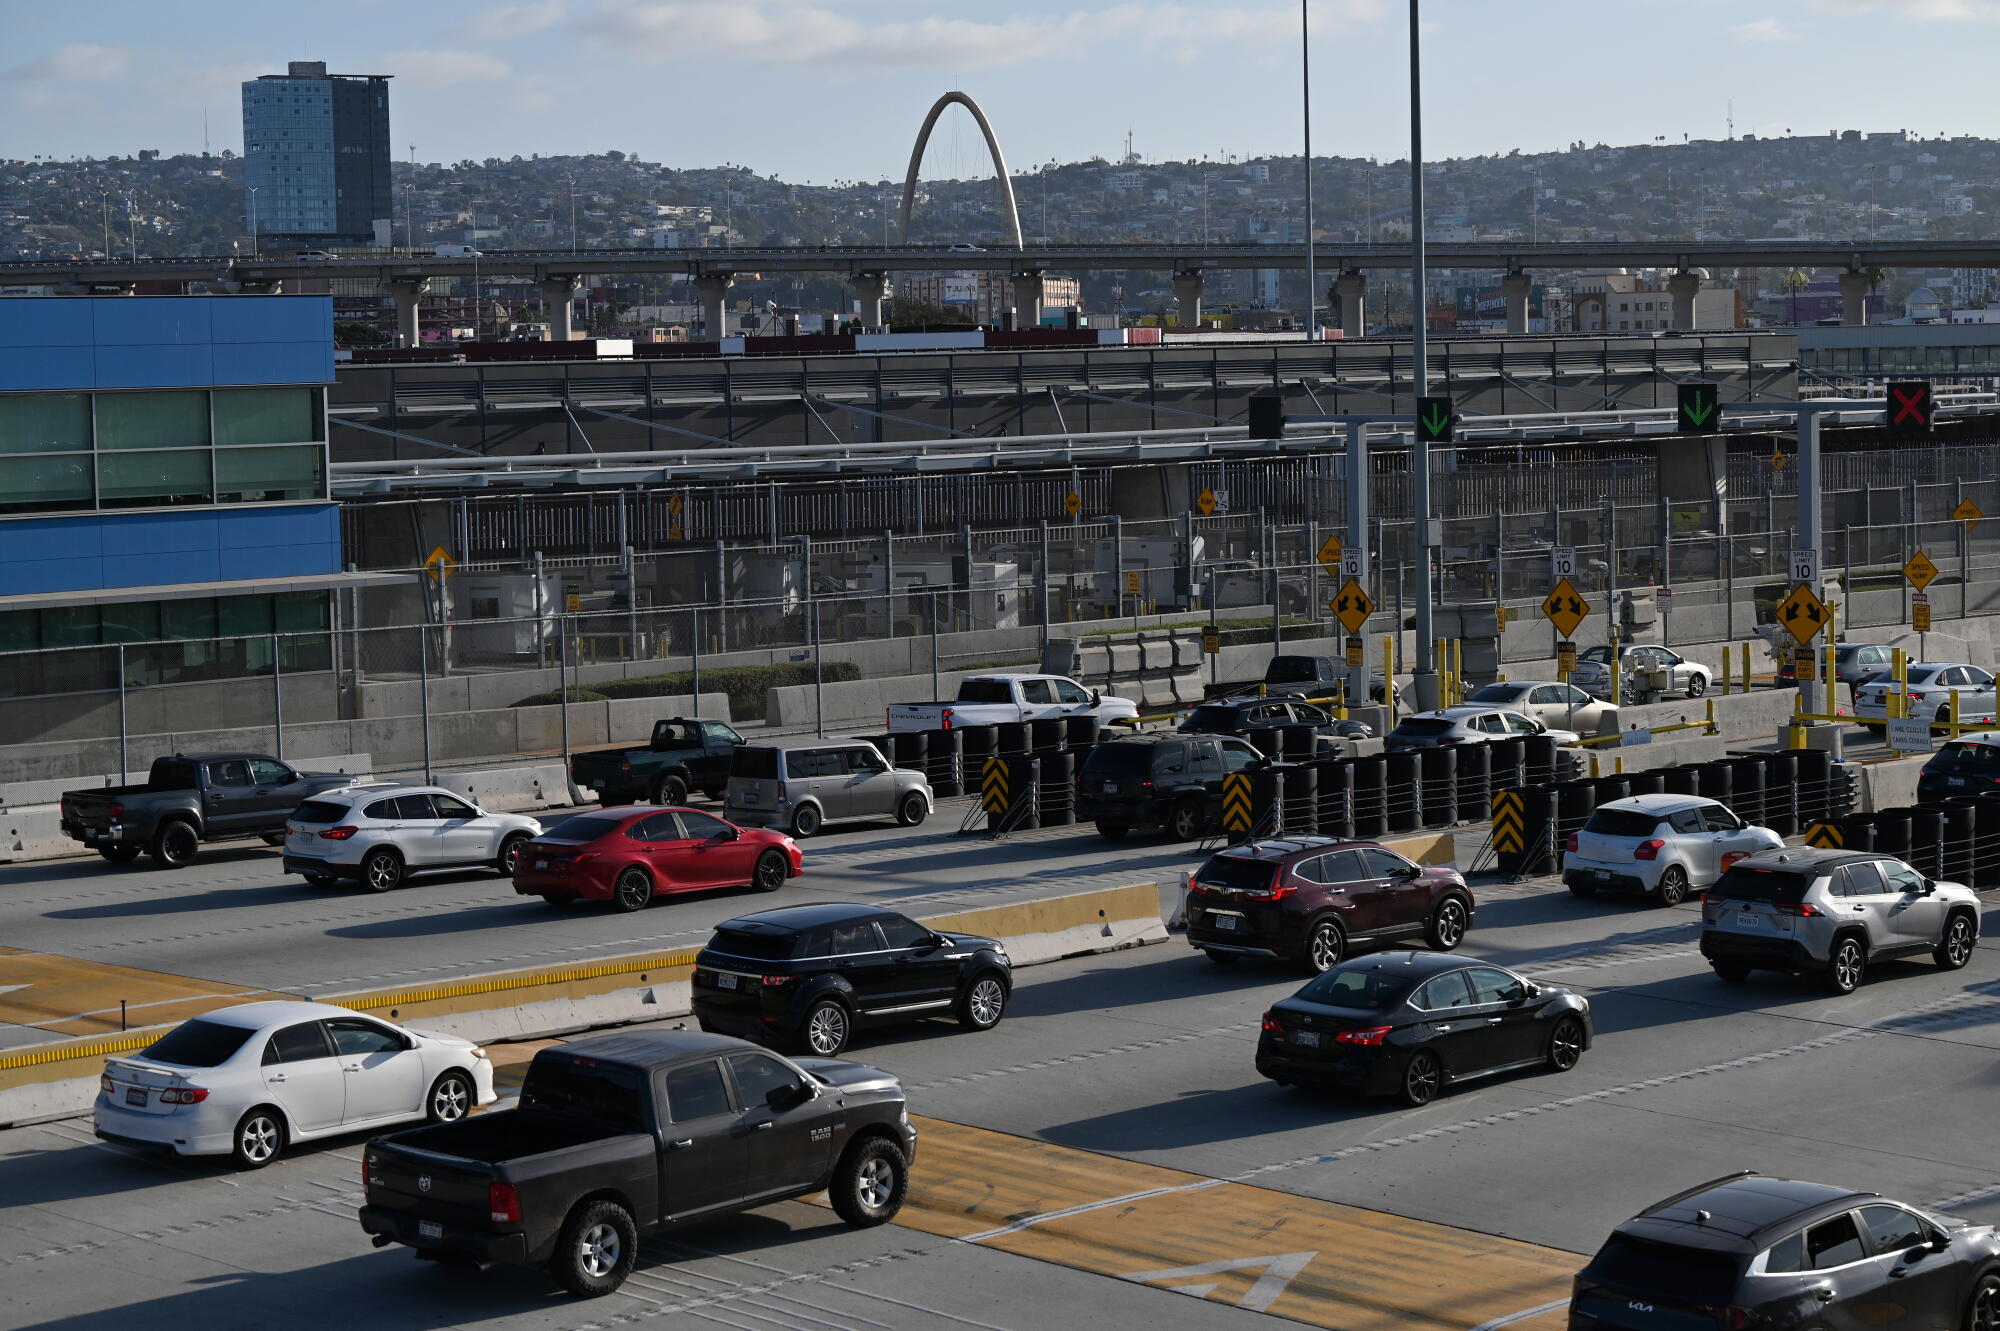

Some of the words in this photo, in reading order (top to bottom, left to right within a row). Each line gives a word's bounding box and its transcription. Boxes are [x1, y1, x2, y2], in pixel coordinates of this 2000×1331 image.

[1345, 561, 1358, 573] 10
[1556, 560, 1571, 574] 10
[1795, 564, 1811, 579] 10
[891, 713, 936, 721] CHEVROLET
[810, 1126, 831, 1136] RAM
[811, 1132, 831, 1142] 1500
[1628, 1300, 1654, 1312] KIA
